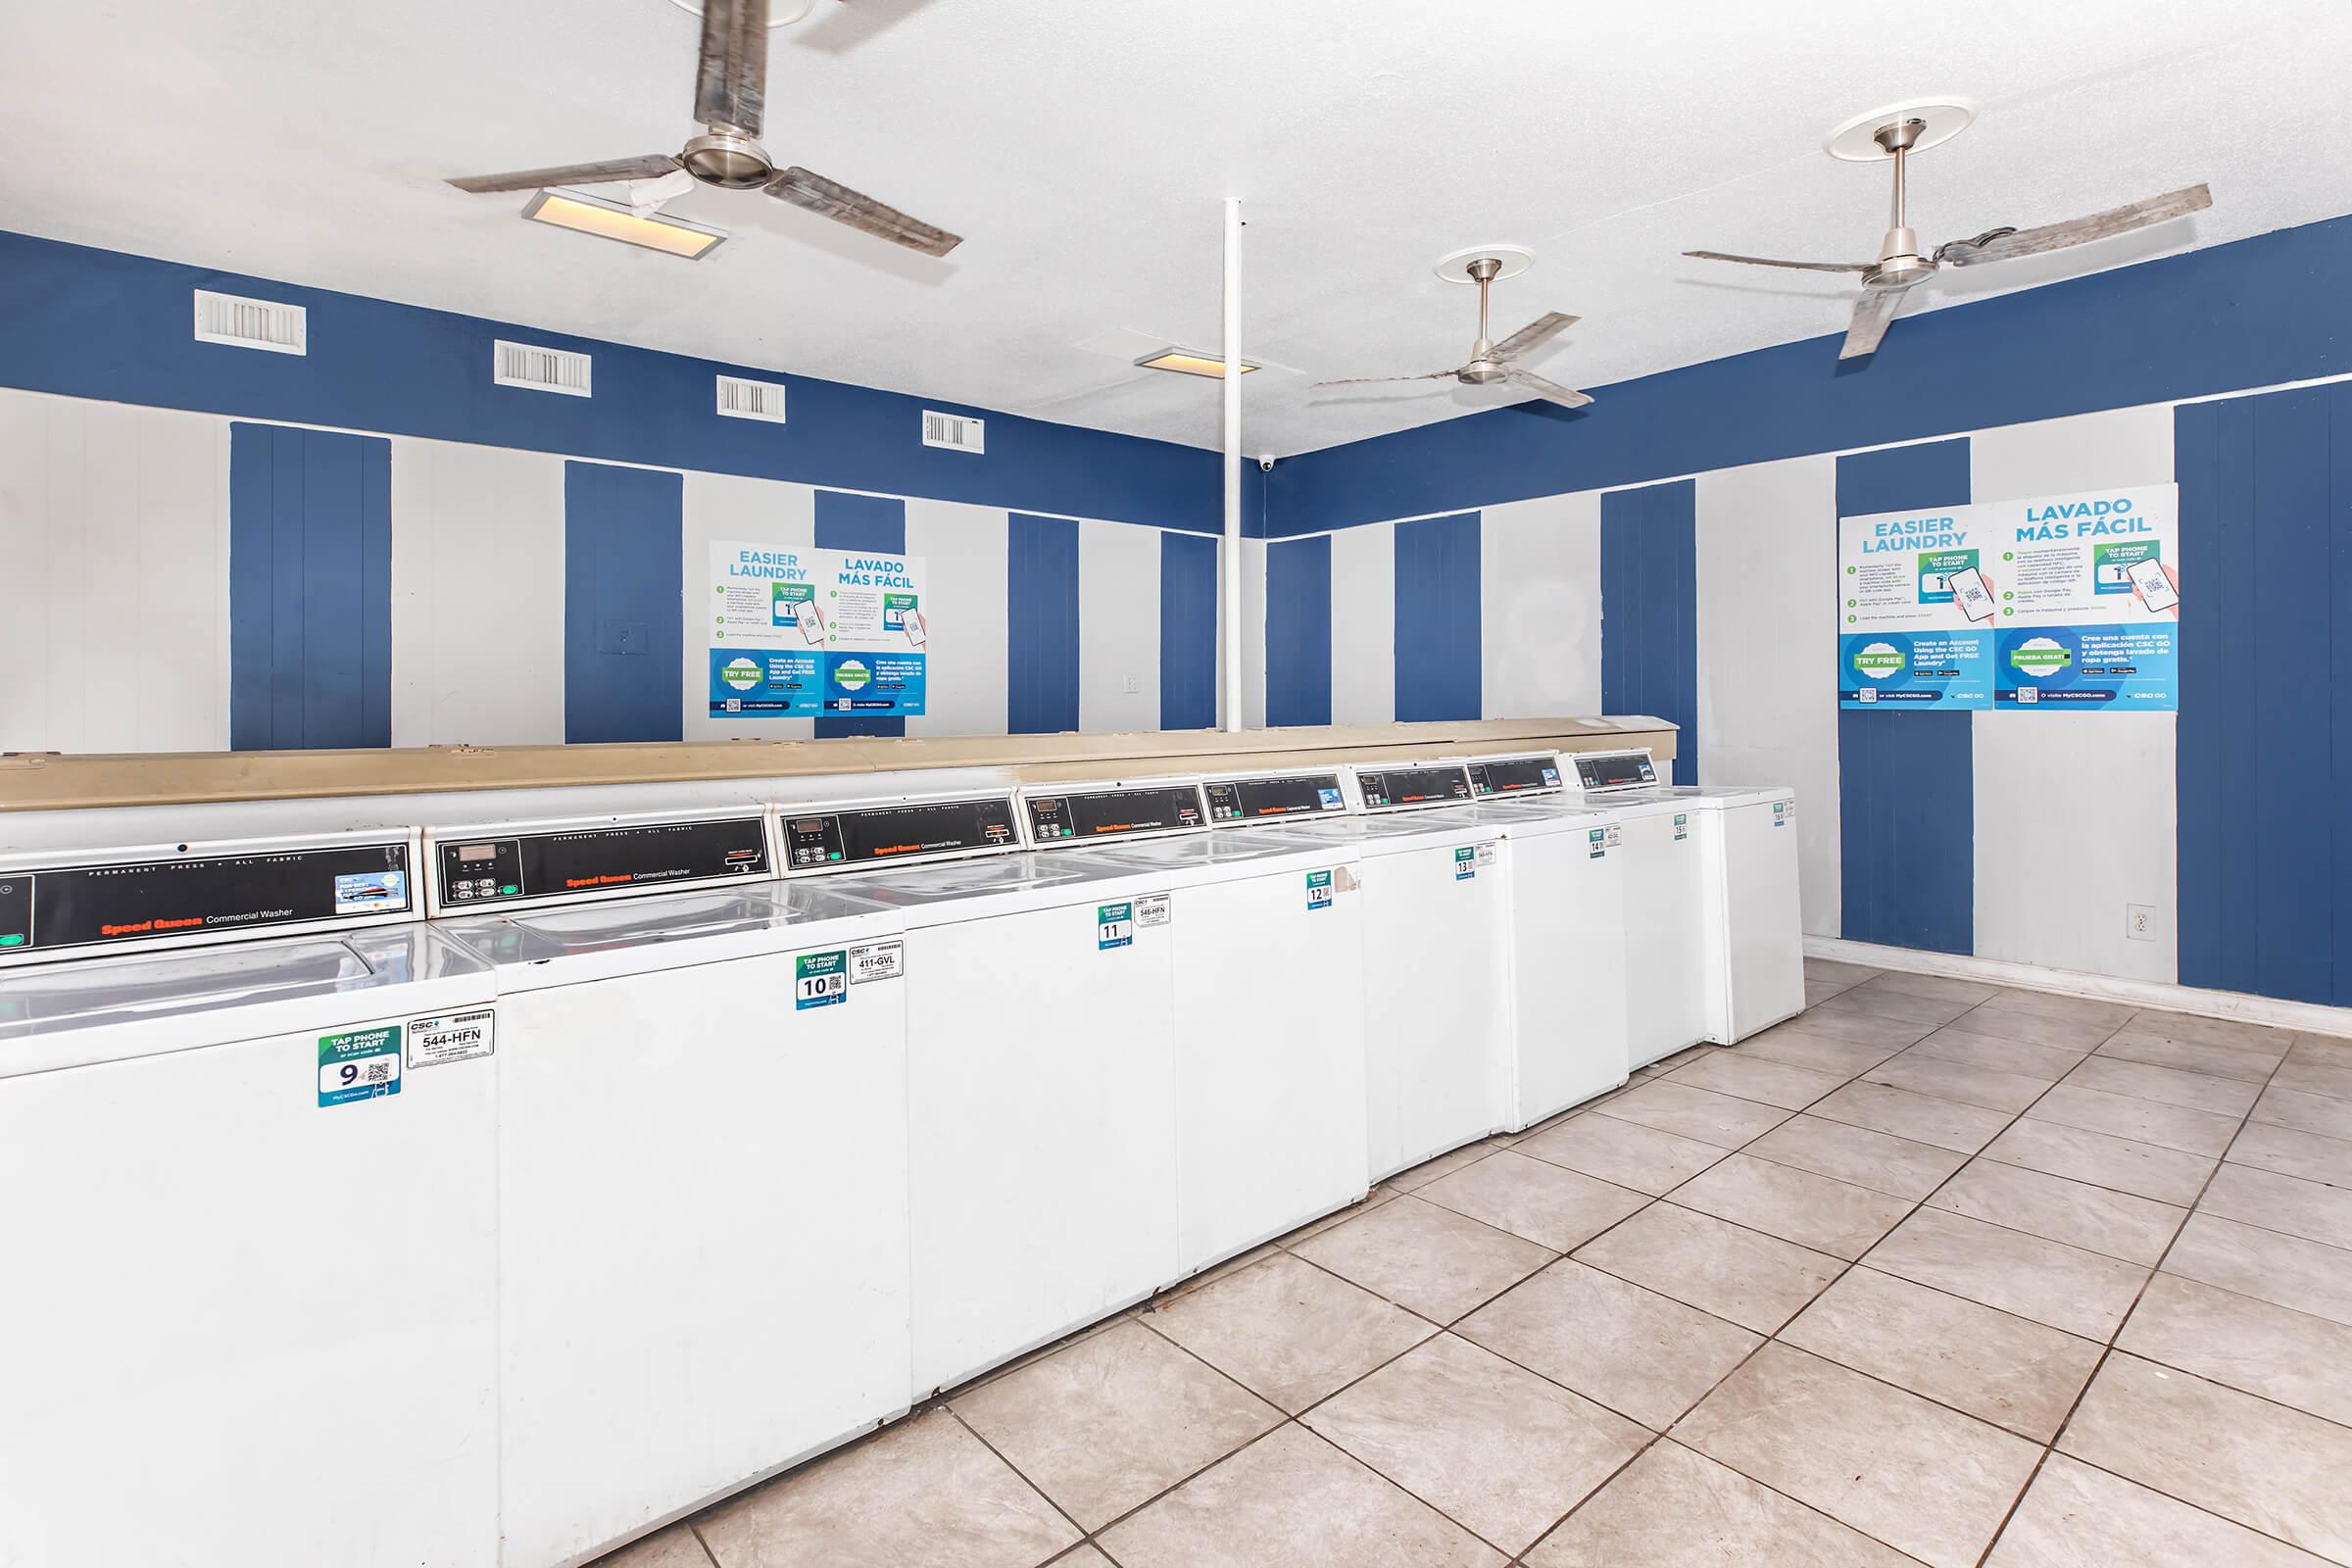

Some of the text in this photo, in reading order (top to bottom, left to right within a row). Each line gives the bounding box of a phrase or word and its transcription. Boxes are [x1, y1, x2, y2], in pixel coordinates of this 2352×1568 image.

[2027, 498, 2132, 522] LAVADO
[1875, 517, 1954, 537] EASIER
[2016, 516, 2153, 542] MÁS FÁCIL
[1862, 532, 1968, 553] LAUNDRY
[739, 551, 798, 566] EASIER
[845, 558, 905, 573] LAVADO
[730, 564, 808, 580] LAUNDRY
[838, 571, 914, 588] MÁS FÁCIL
[1592, 842, 1599, 851] 14
[88, 866, 157, 877] PERMANENT
[1458, 862, 1467, 872] 13
[566, 868, 691, 888] Speed Queen Commercial Washer
[1311, 888, 1323, 901] 12
[101, 908, 294, 935] Speed Queen Commercial Washer
[1104, 924, 1117, 939] 11
[816, 960, 836, 969] START
[817, 955, 839, 963] PHONE
[859, 956, 895, 968] 411-GVL
[804, 978, 827, 996] 10
[411, 1022, 433, 1030] CSC
[331, 1031, 390, 1047] TAP PHONE
[352, 1038, 385, 1050] START
[423, 1029, 481, 1048] 544-HFN
[340, 1064, 358, 1086] 9
